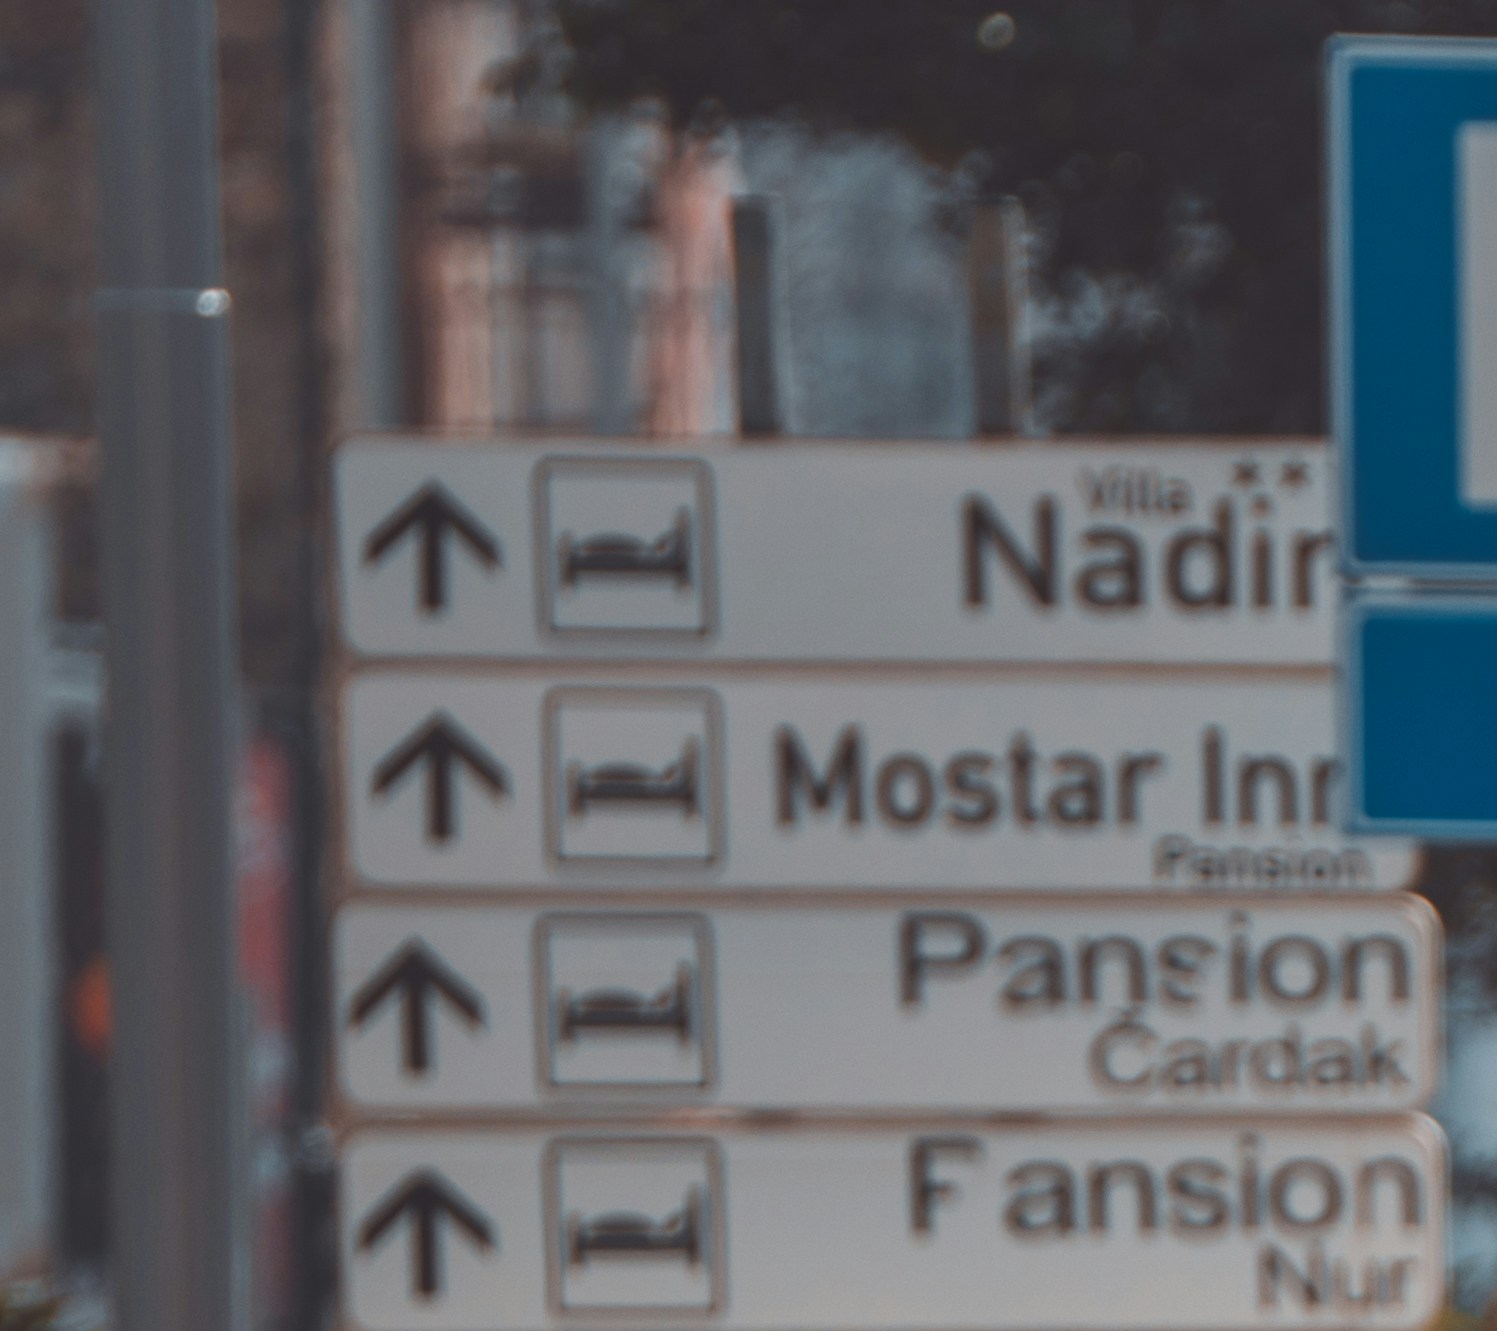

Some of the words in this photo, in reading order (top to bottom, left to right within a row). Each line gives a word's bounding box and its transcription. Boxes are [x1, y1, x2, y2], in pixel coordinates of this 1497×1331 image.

[1082, 466, 1192, 517] Villa
[772, 722, 1166, 832] Mostar
[896, 908, 1414, 1014] Pansion
[1255, 1240, 1420, 1310] Nur
